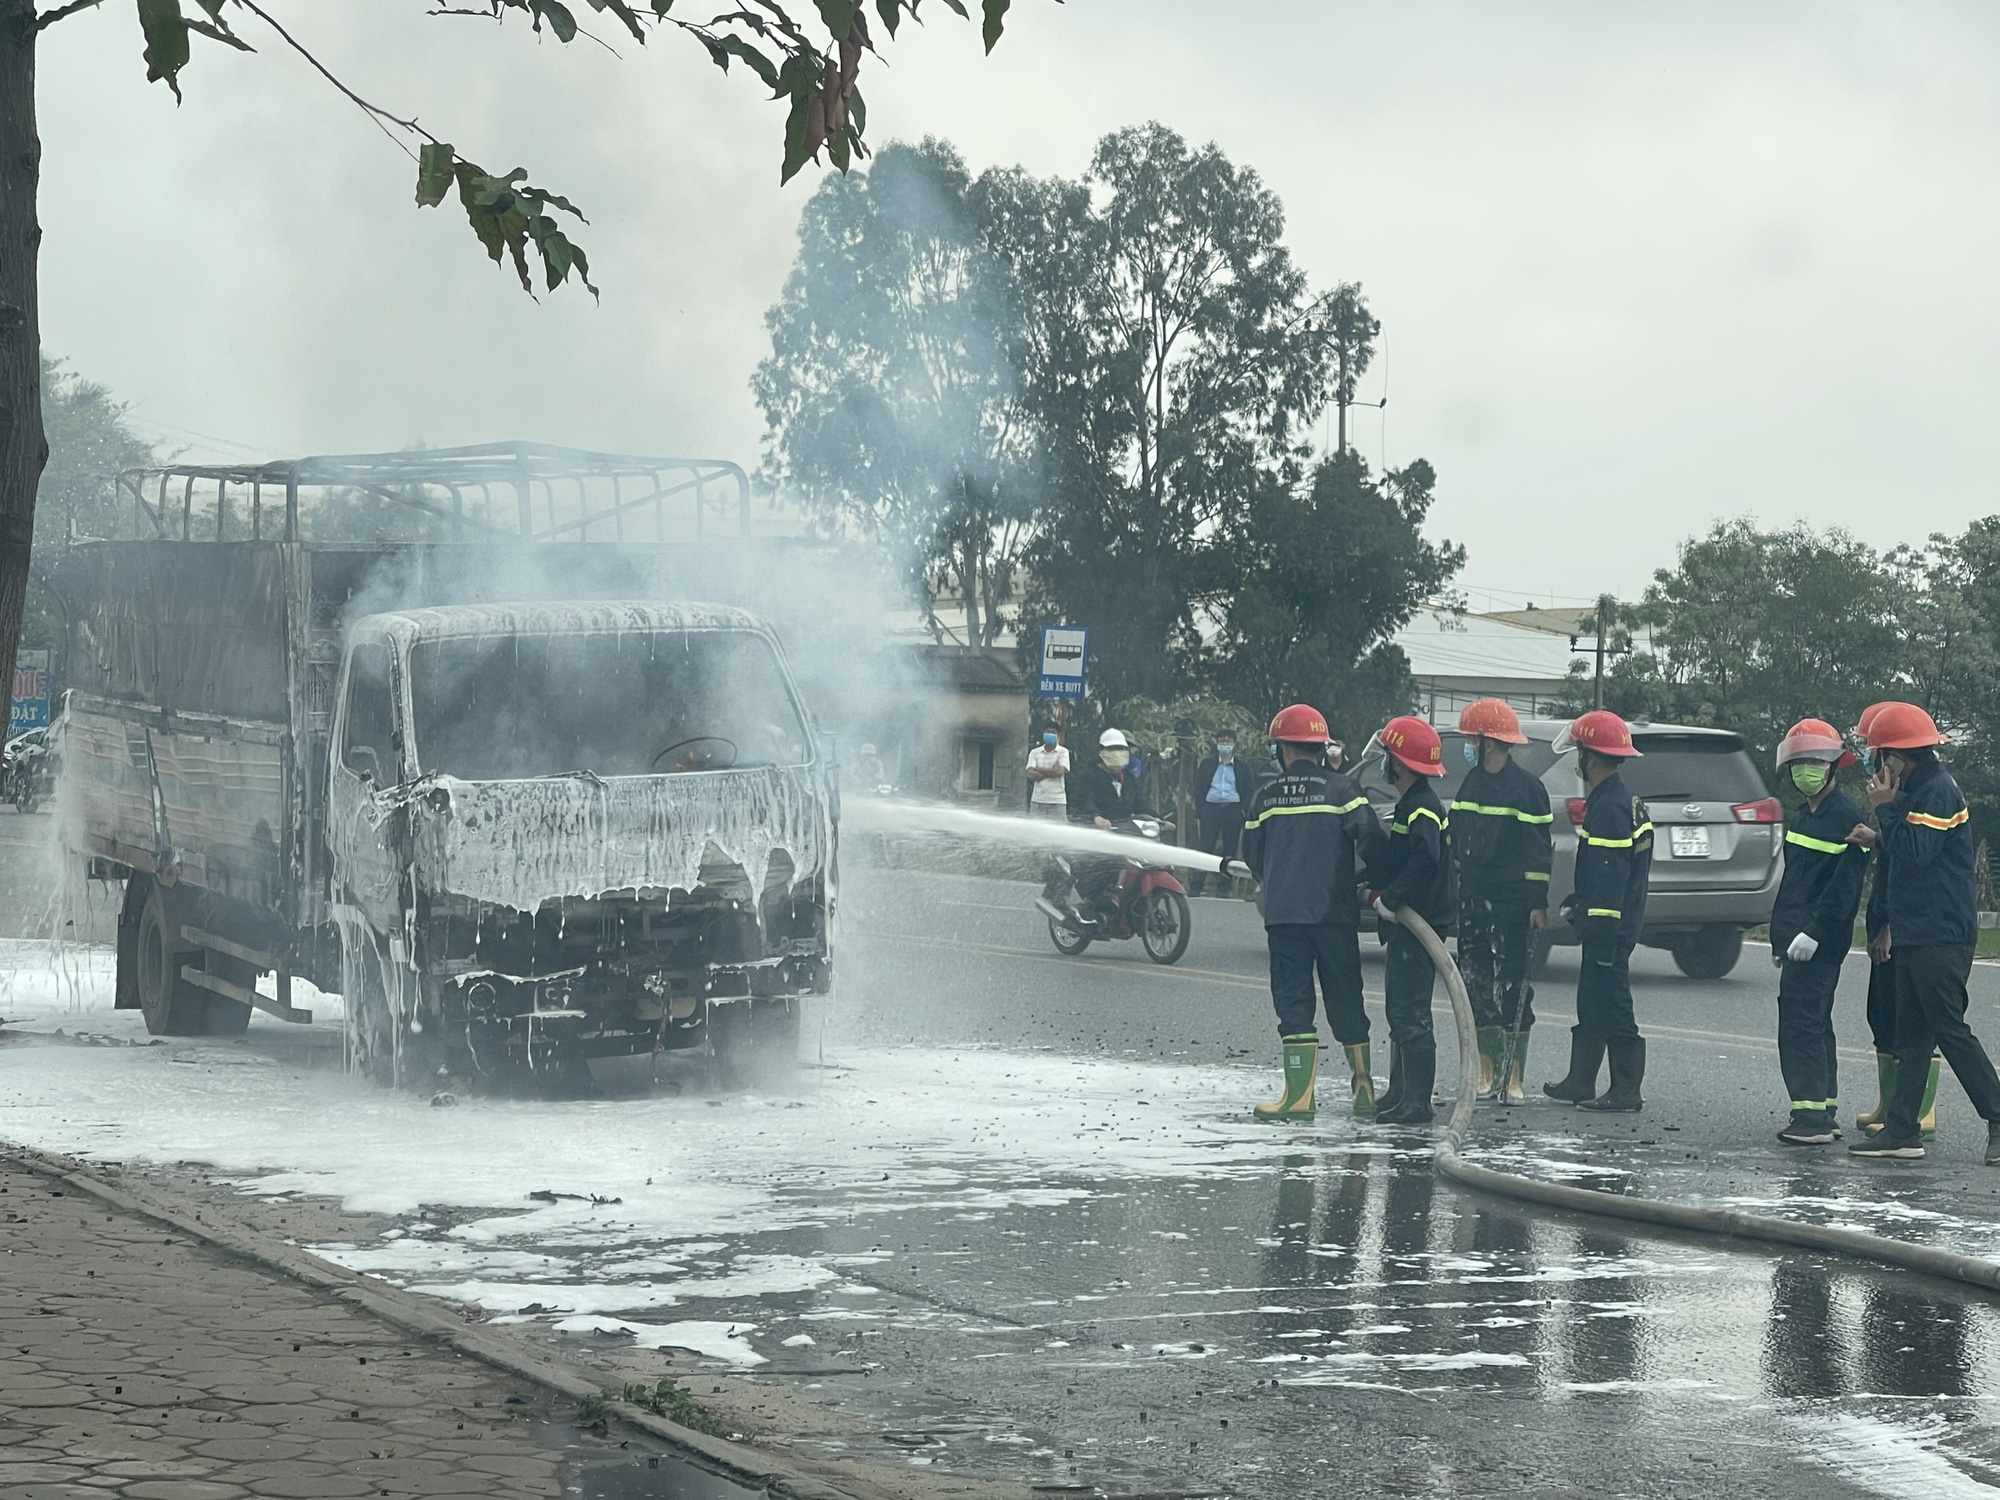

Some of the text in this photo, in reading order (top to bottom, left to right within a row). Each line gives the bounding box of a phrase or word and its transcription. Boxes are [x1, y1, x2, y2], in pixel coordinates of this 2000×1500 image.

[1055, 681, 1064, 692] XE
[1310, 721, 1326, 733] HD
[1579, 726, 1595, 738] 114
[1386, 729, 1404, 748] 114
[1282, 784, 1306, 795] 114
